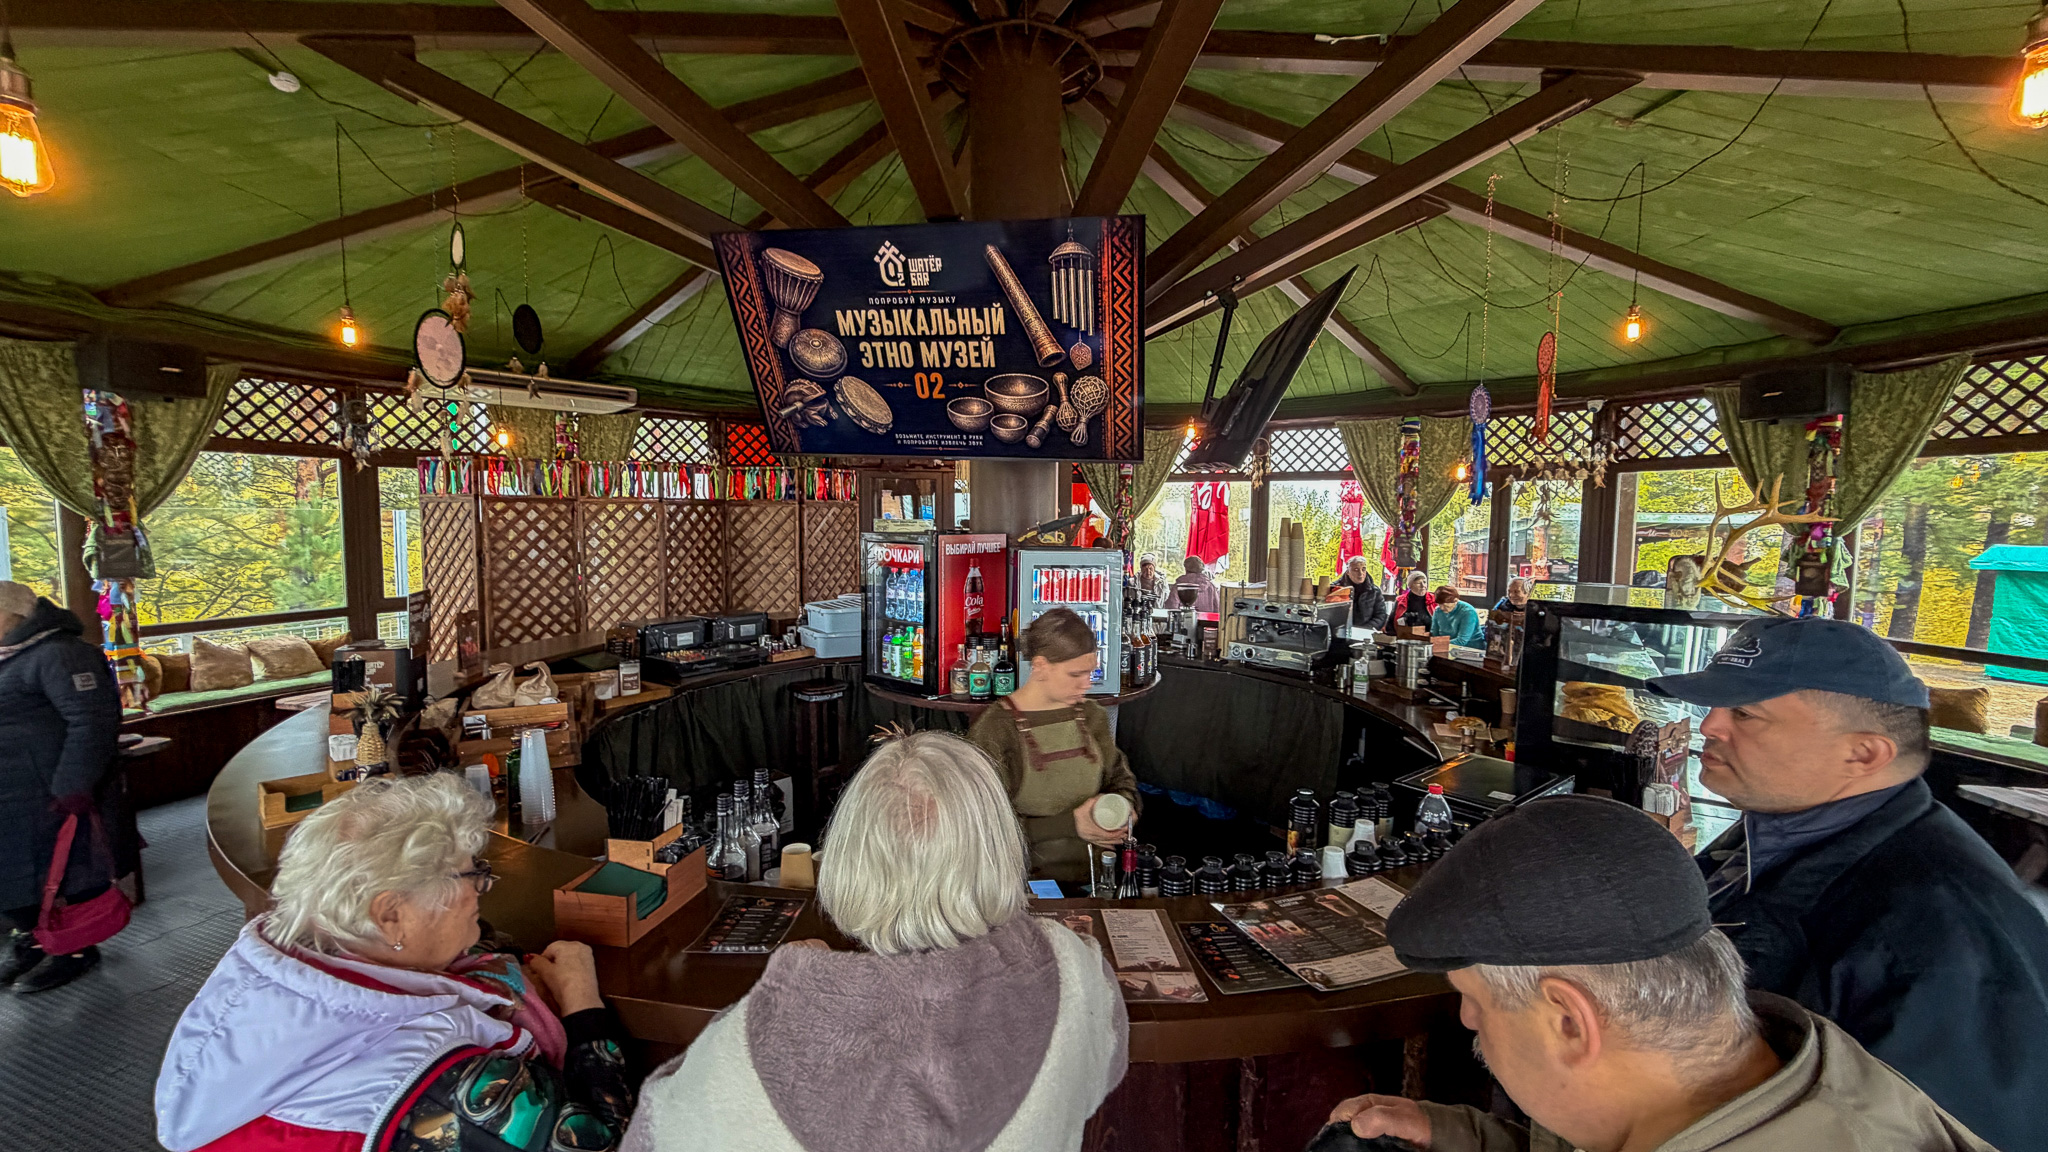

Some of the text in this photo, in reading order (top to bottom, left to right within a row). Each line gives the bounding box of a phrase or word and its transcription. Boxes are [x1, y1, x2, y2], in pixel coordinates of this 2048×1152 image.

[908, 255, 942, 272] ШАТЁР
[910, 272, 930, 286] БАР
[868, 295, 956, 305] ПОПРОБУЙ МУЗЫКУ
[835, 302, 1006, 337] МУЗЫКАЛЬНЫЙ
[859, 336, 996, 369] ЭТНО МУЗЕЙ
[914, 372, 946, 400] 02
[877, 547, 920, 564] БОЧКАРИ
[945, 541, 1001, 556] ВЫБИРАЙ ЛУЧШЕЕ
[965, 594, 984, 607] Cola
